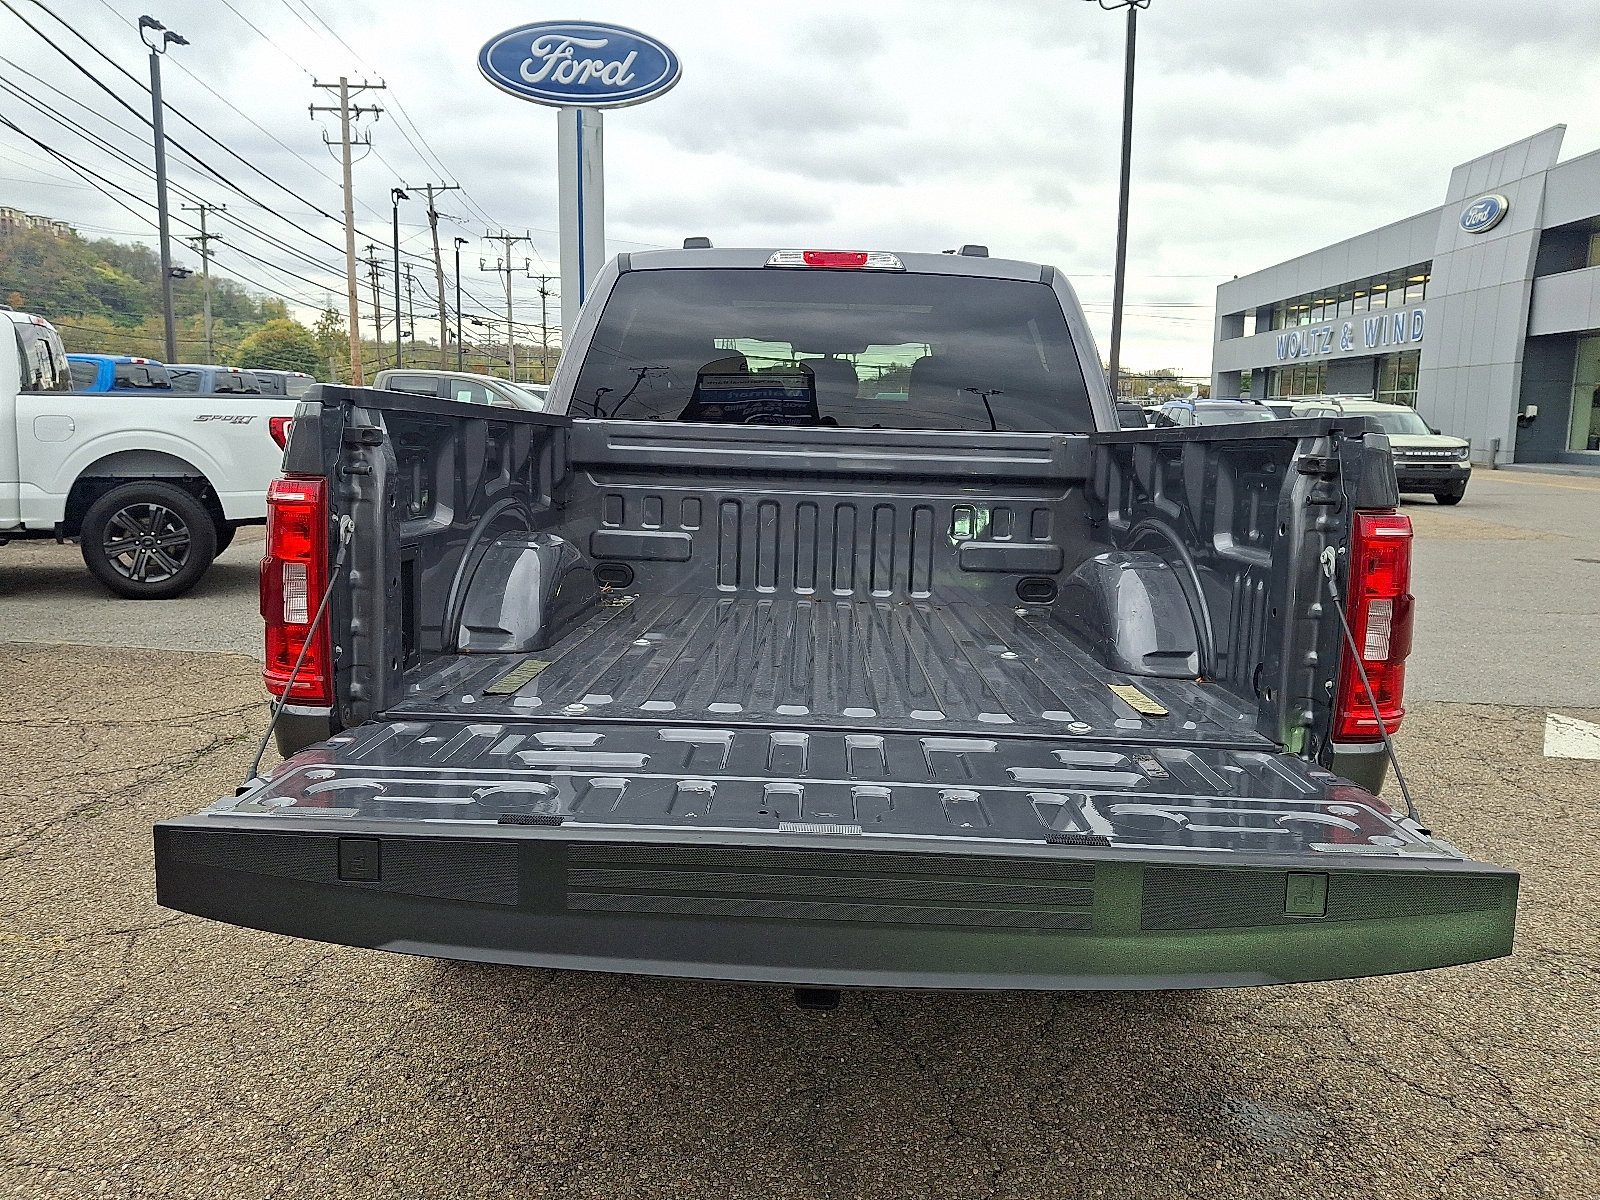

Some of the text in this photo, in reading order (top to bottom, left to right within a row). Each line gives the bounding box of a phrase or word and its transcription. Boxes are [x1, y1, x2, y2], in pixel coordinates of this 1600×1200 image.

[519, 34, 639, 86] Ford
[1465, 203, 1491, 226] Ford
[1276, 308, 1426, 360] WOLTZ & WIND
[193, 414, 258, 424] SPORT
